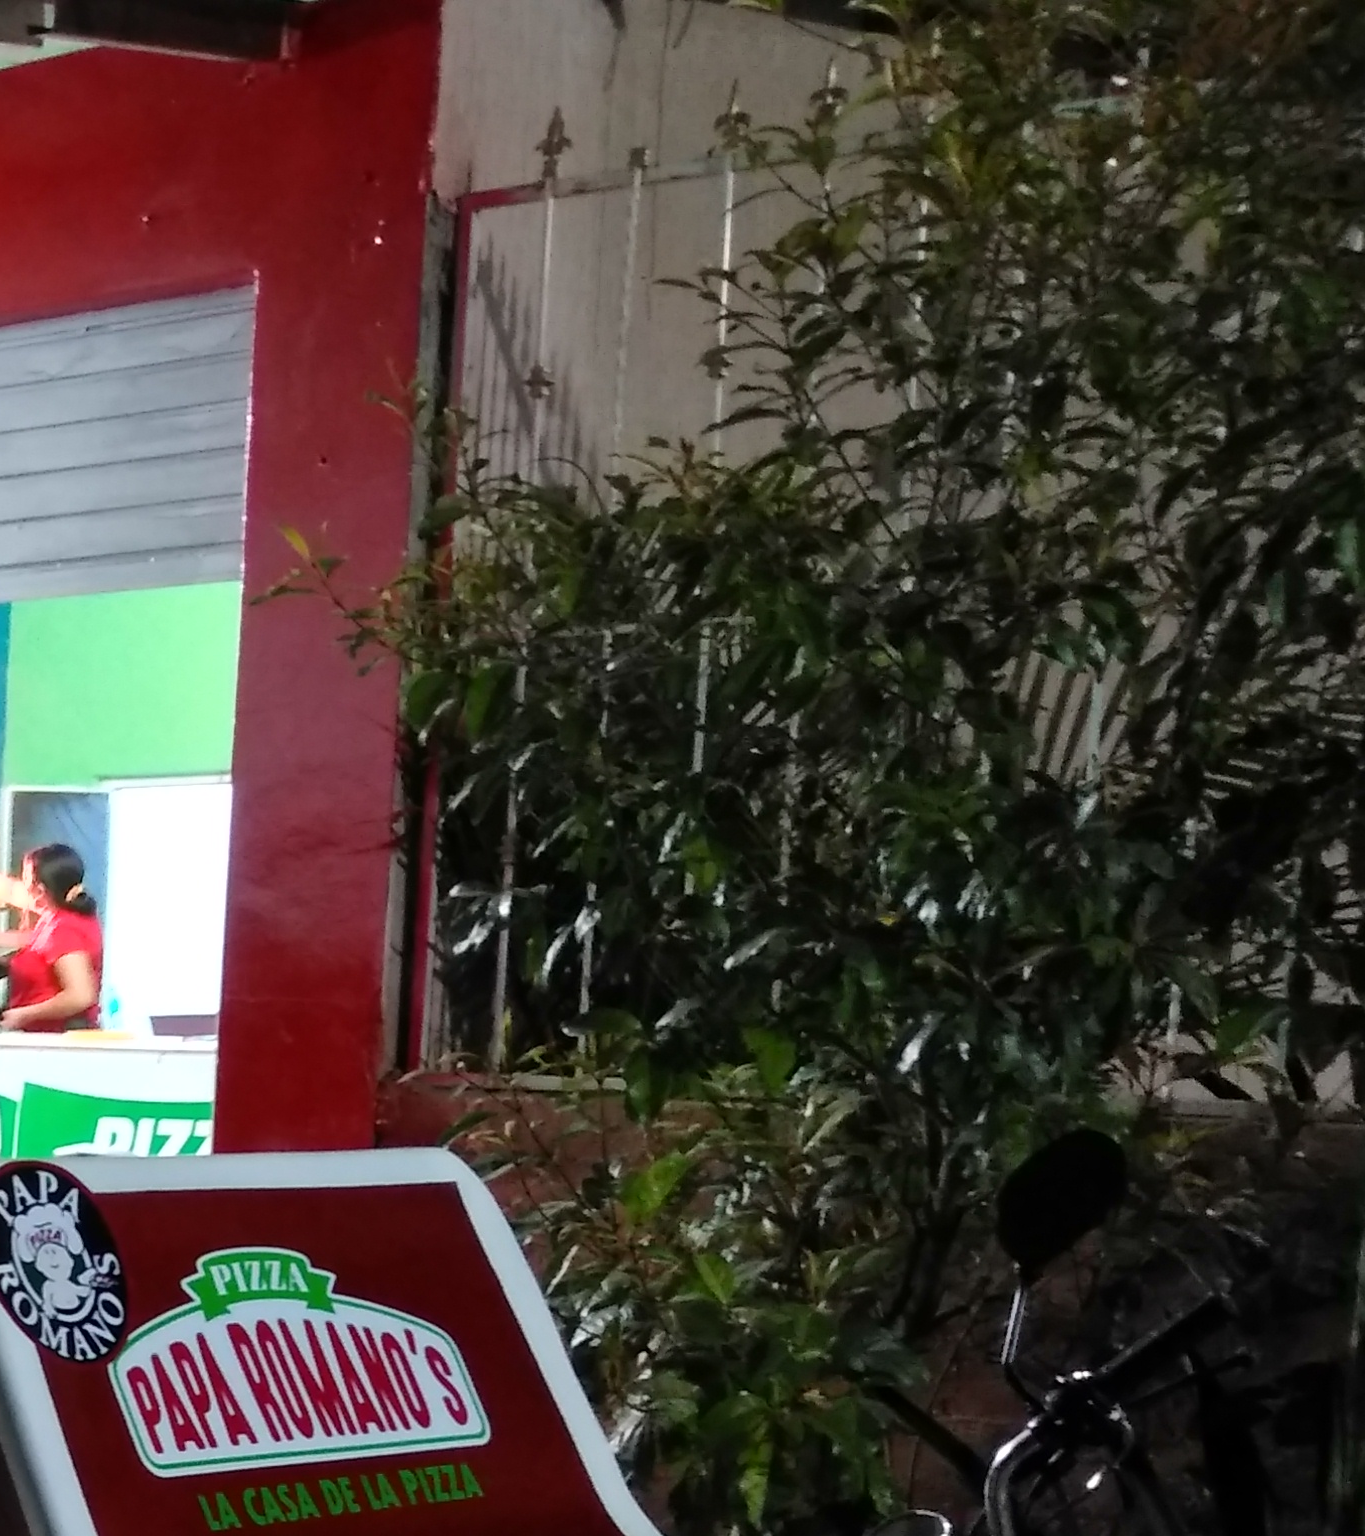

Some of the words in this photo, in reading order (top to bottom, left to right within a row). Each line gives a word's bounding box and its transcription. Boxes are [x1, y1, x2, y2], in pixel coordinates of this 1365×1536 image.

[209, 1260, 309, 1296] PIZZA
[127, 1332, 259, 1454] PAPA
[227, 1318, 468, 1442] ROMANO'S
[198, 1492, 242, 1532] LA
[242, 1483, 320, 1526] CASA
[319, 1476, 361, 1515] DE
[360, 1473, 402, 1512] LA
[398, 1463, 484, 1506] PIZZA
